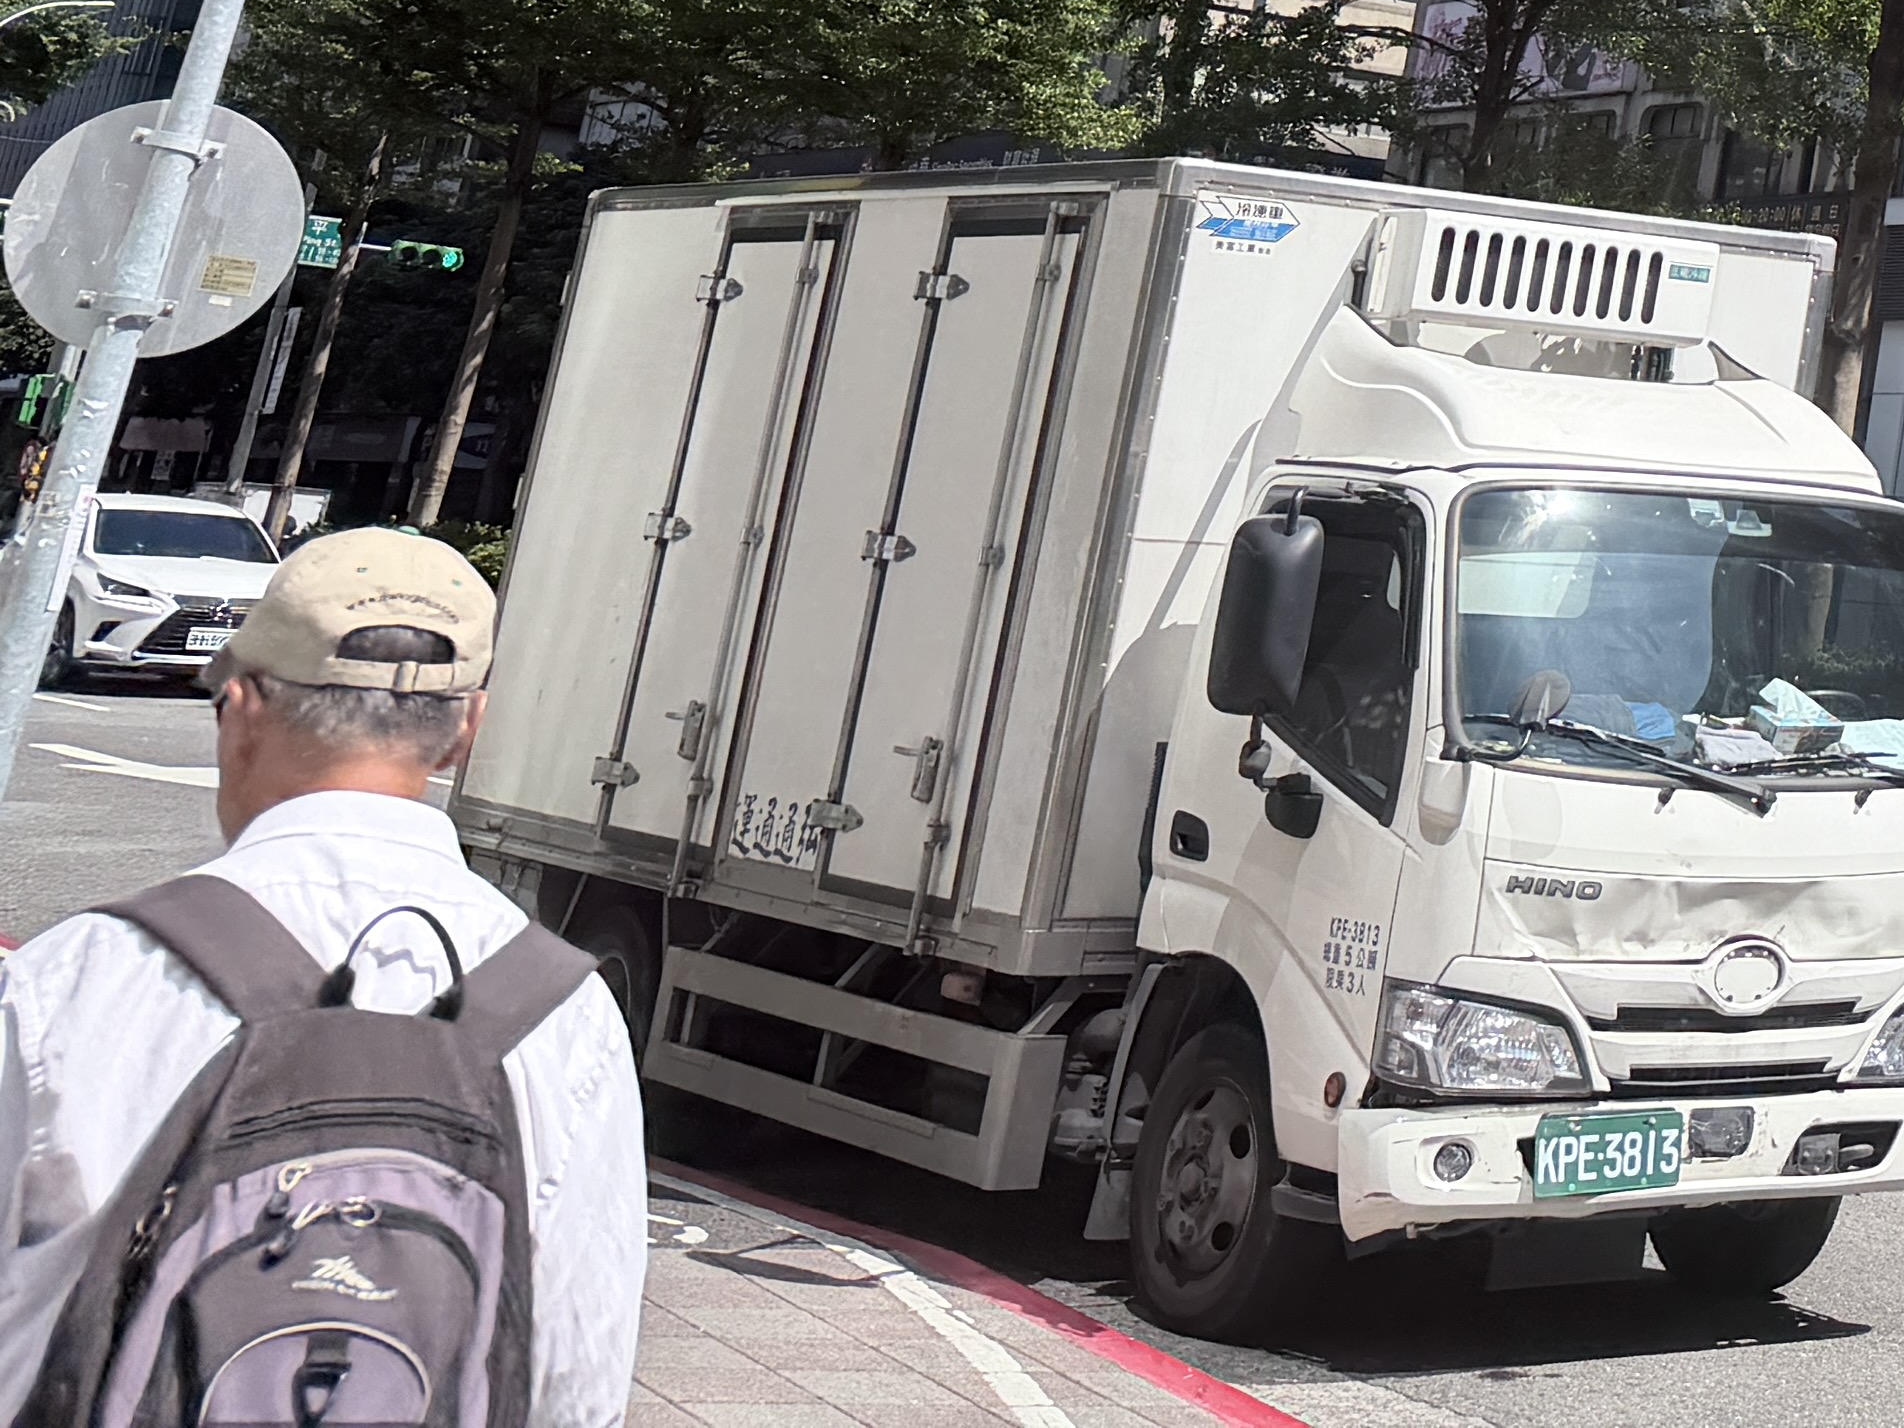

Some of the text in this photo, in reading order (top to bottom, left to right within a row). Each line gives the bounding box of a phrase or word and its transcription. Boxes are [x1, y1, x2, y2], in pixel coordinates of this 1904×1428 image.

[1505, 876, 1603, 901] HINO
[1329, 916, 1381, 947] KPE-3813
[1536, 1127, 1681, 1185] KPE-3813
